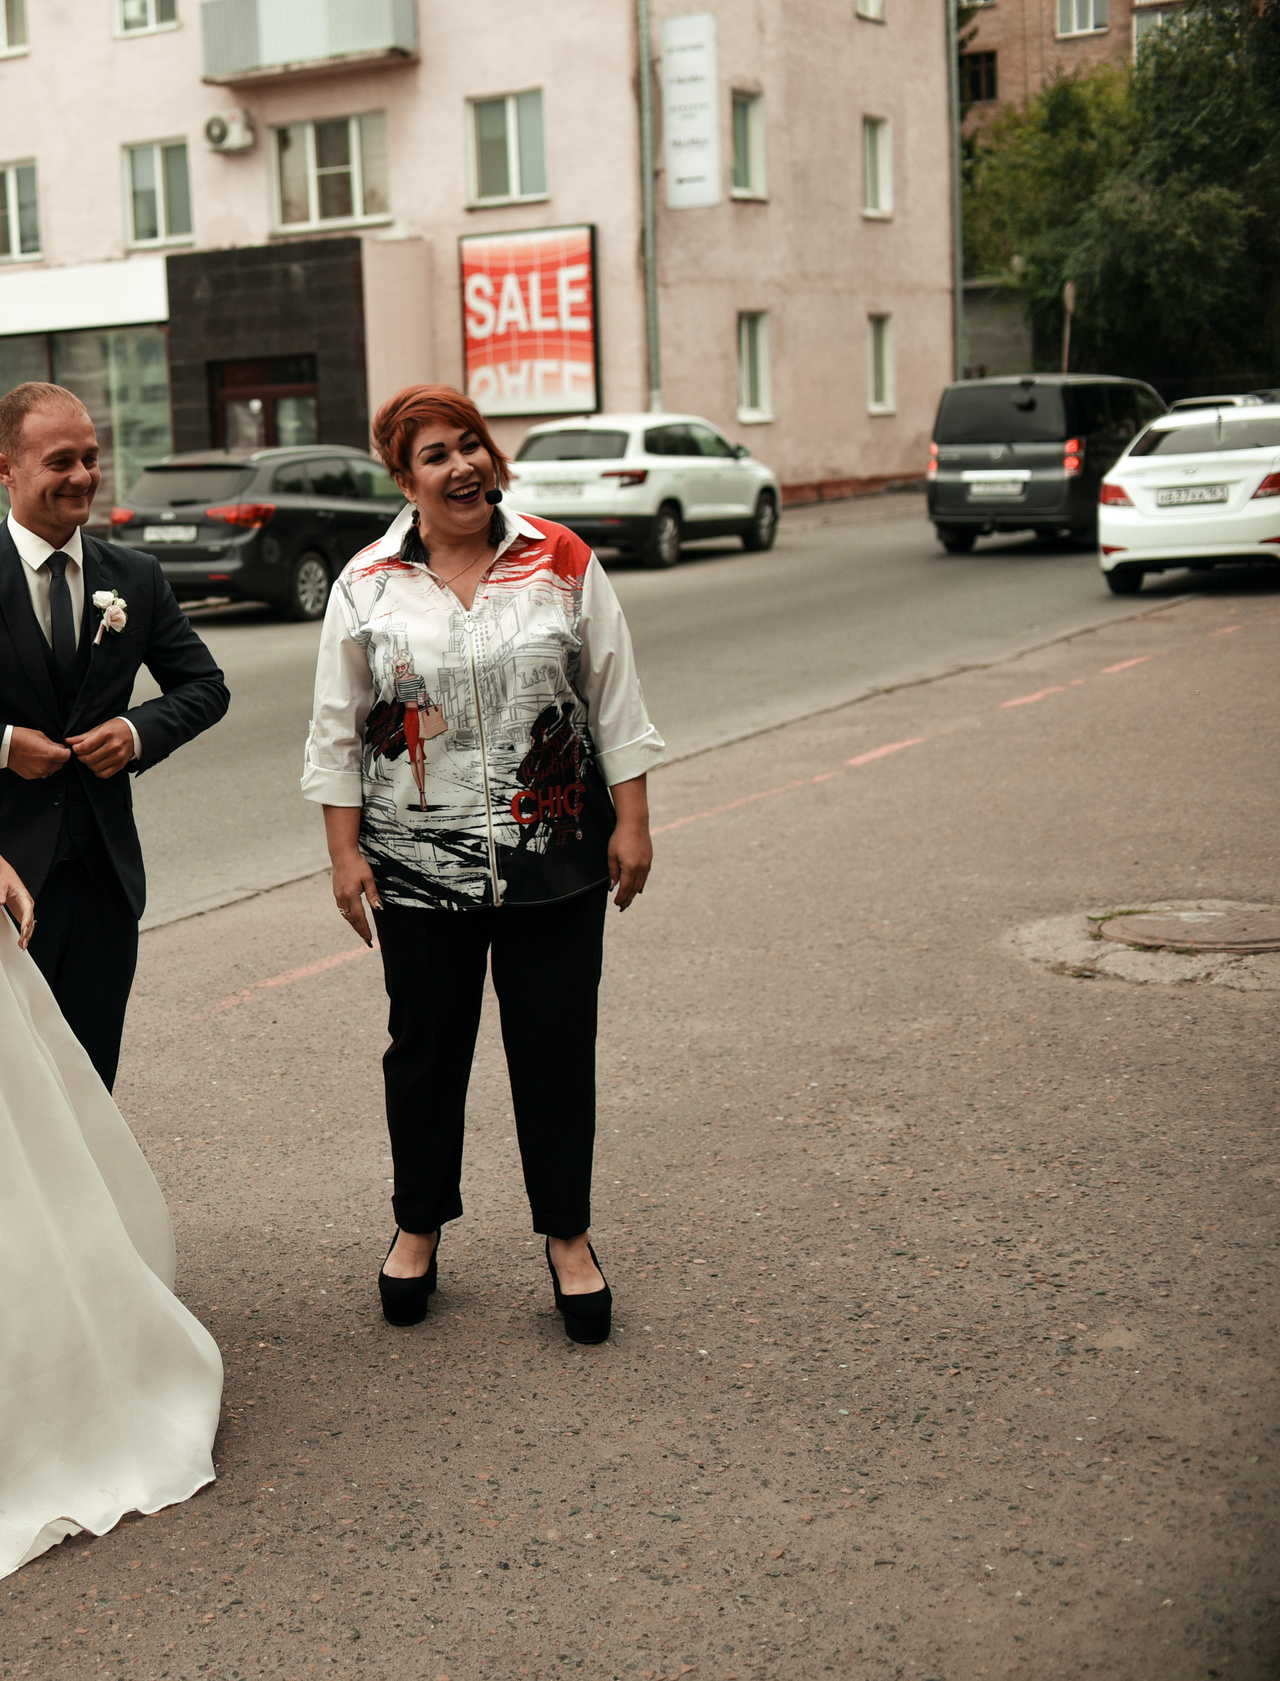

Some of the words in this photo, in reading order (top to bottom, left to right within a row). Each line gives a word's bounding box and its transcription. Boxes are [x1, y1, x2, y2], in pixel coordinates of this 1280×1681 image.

[464, 263, 591, 340] SALE
[518, 665, 558, 690] Life
[510, 783, 587, 825] CHIC
